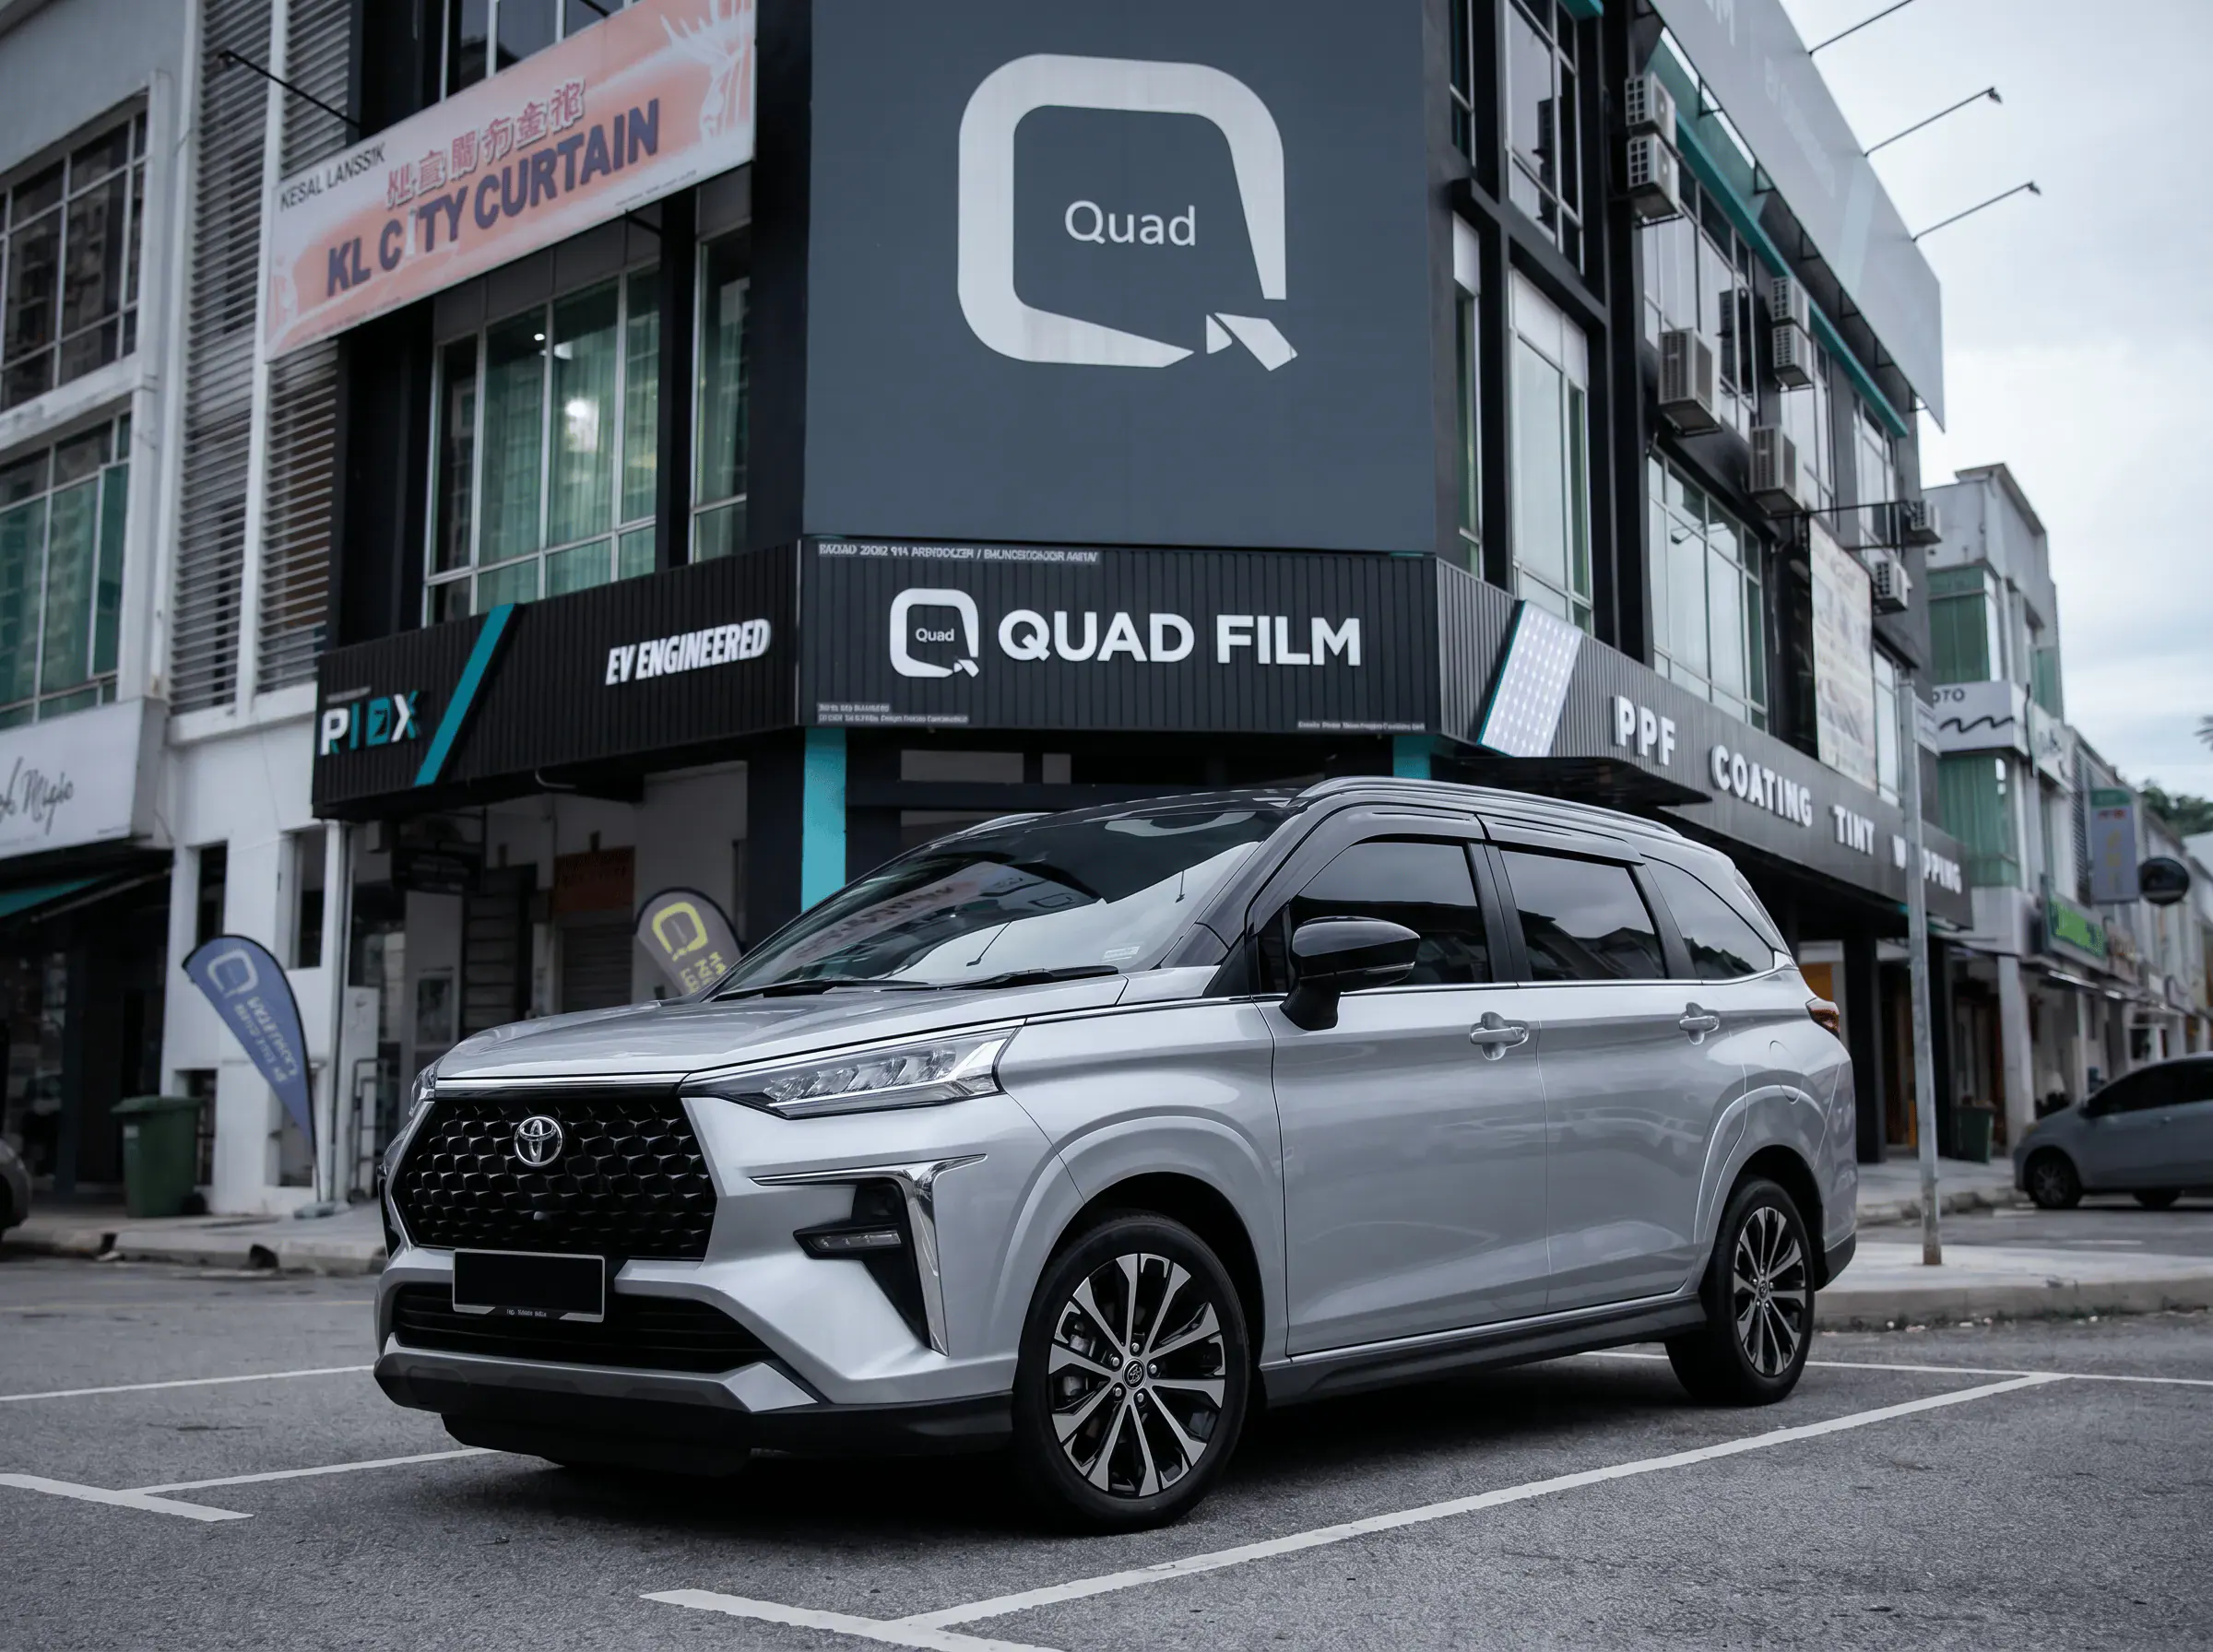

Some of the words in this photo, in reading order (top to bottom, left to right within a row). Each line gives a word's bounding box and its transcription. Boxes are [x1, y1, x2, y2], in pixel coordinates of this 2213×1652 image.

[327, 237, 372, 297] KL
[379, 187, 467, 271] CITY
[475, 98, 658, 229] CURTAIN
[1064, 200, 1196, 246] Quad
[606, 644, 637, 686] EV
[635, 619, 772, 680] ENGINEERED
[916, 627, 955, 644] Quad
[998, 609, 1195, 662] QUAD
[1216, 614, 1361, 667] FILM
[1615, 694, 1675, 766] PPF
[1711, 744, 1813, 828] COATING
[1832, 803, 1875, 856] TINT
